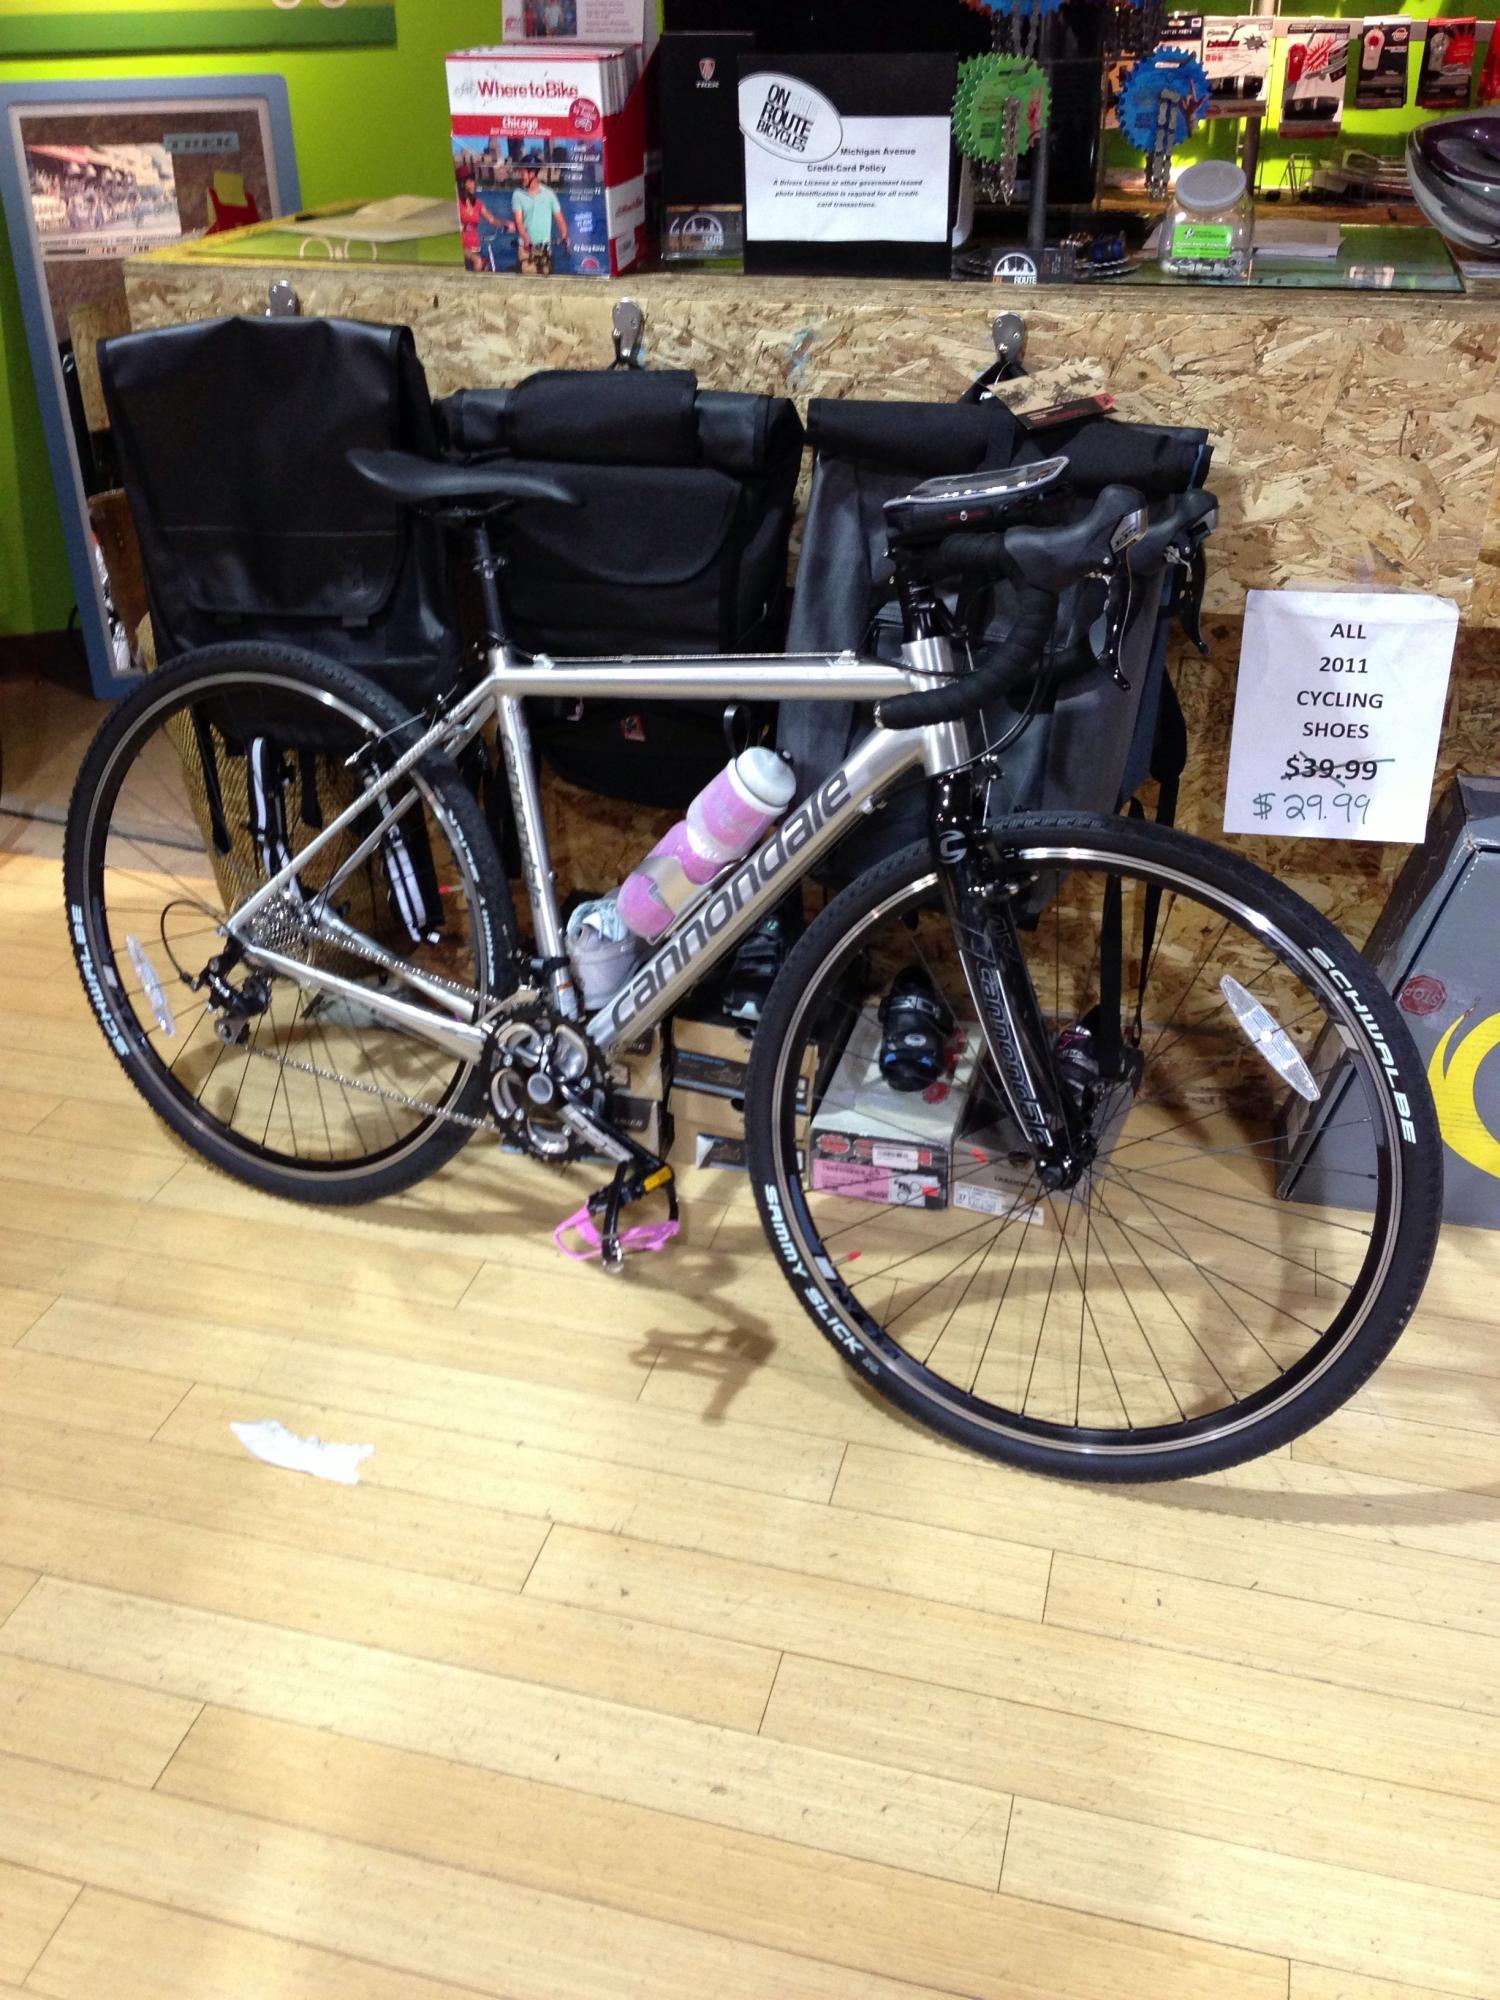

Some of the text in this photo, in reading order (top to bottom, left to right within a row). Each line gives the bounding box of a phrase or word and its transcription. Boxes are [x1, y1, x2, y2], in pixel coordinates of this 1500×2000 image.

[477, 80, 527, 98] Where
[529, 81, 545, 98] to
[546, 80, 579, 98] Bike
[768, 84, 791, 109] ON
[760, 101, 815, 138] ROUTE
[756, 119, 808, 152] BICYCLES
[840, 148, 917, 158] Michigan Avenue
[807, 164, 887, 174] Credit-Card Policy
[1330, 623, 1367, 640] ALL
[1319, 656, 1369, 674] 2011
[1296, 690, 1384, 709] CYCLING
[1302, 721, 1369, 739] SHOES
[1284, 755, 1378, 781] $39.99
[611, 770, 850, 1029] cannondale
[72, 903, 130, 1056] SCHWALBE
[1404, 986, 1441, 1005] STOP
[1307, 946, 1417, 1145] SCHWALBE
[764, 1183, 808, 1278] SAMMY
[805, 1286, 865, 1355] SLICK
